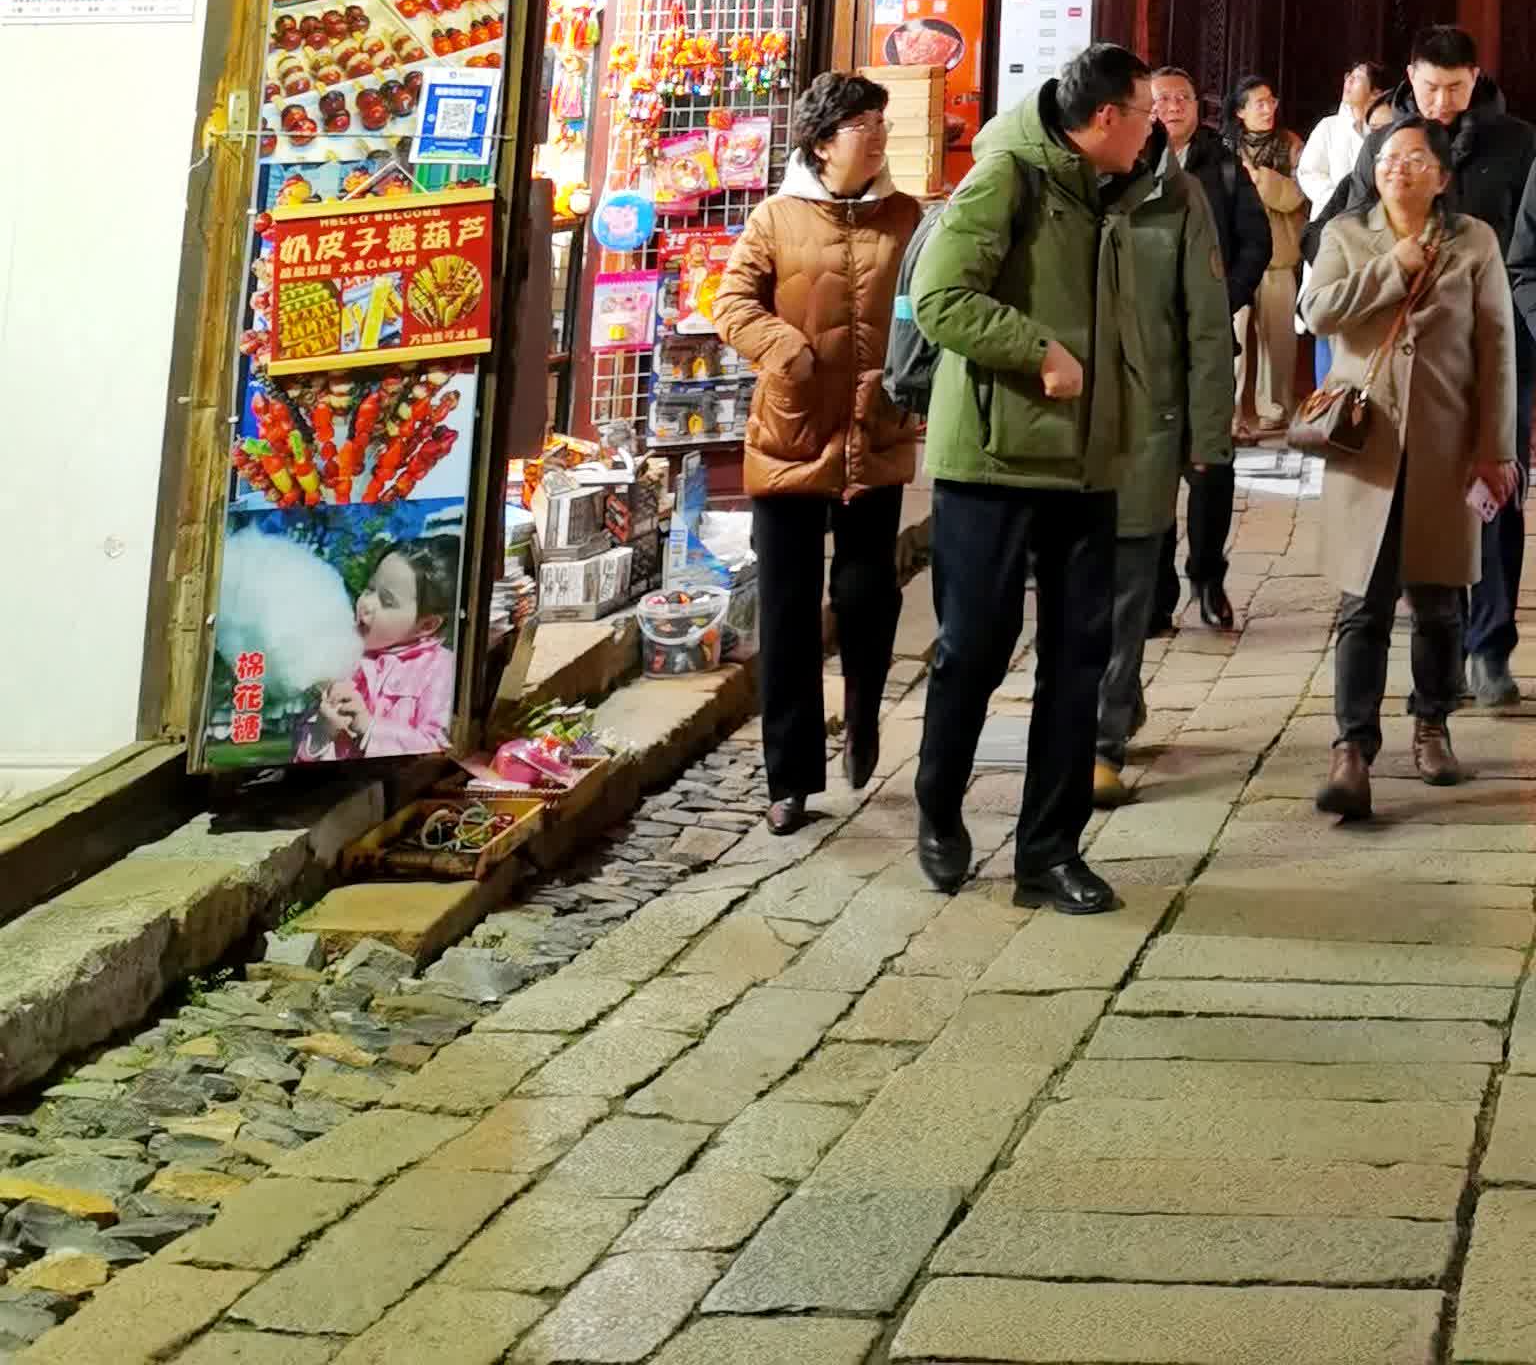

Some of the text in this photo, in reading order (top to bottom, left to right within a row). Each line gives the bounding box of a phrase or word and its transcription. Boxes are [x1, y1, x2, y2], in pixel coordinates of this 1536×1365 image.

[279, 215, 486, 264] 奶皮子糖葫芦
[231, 651, 265, 743] 棉花糖
